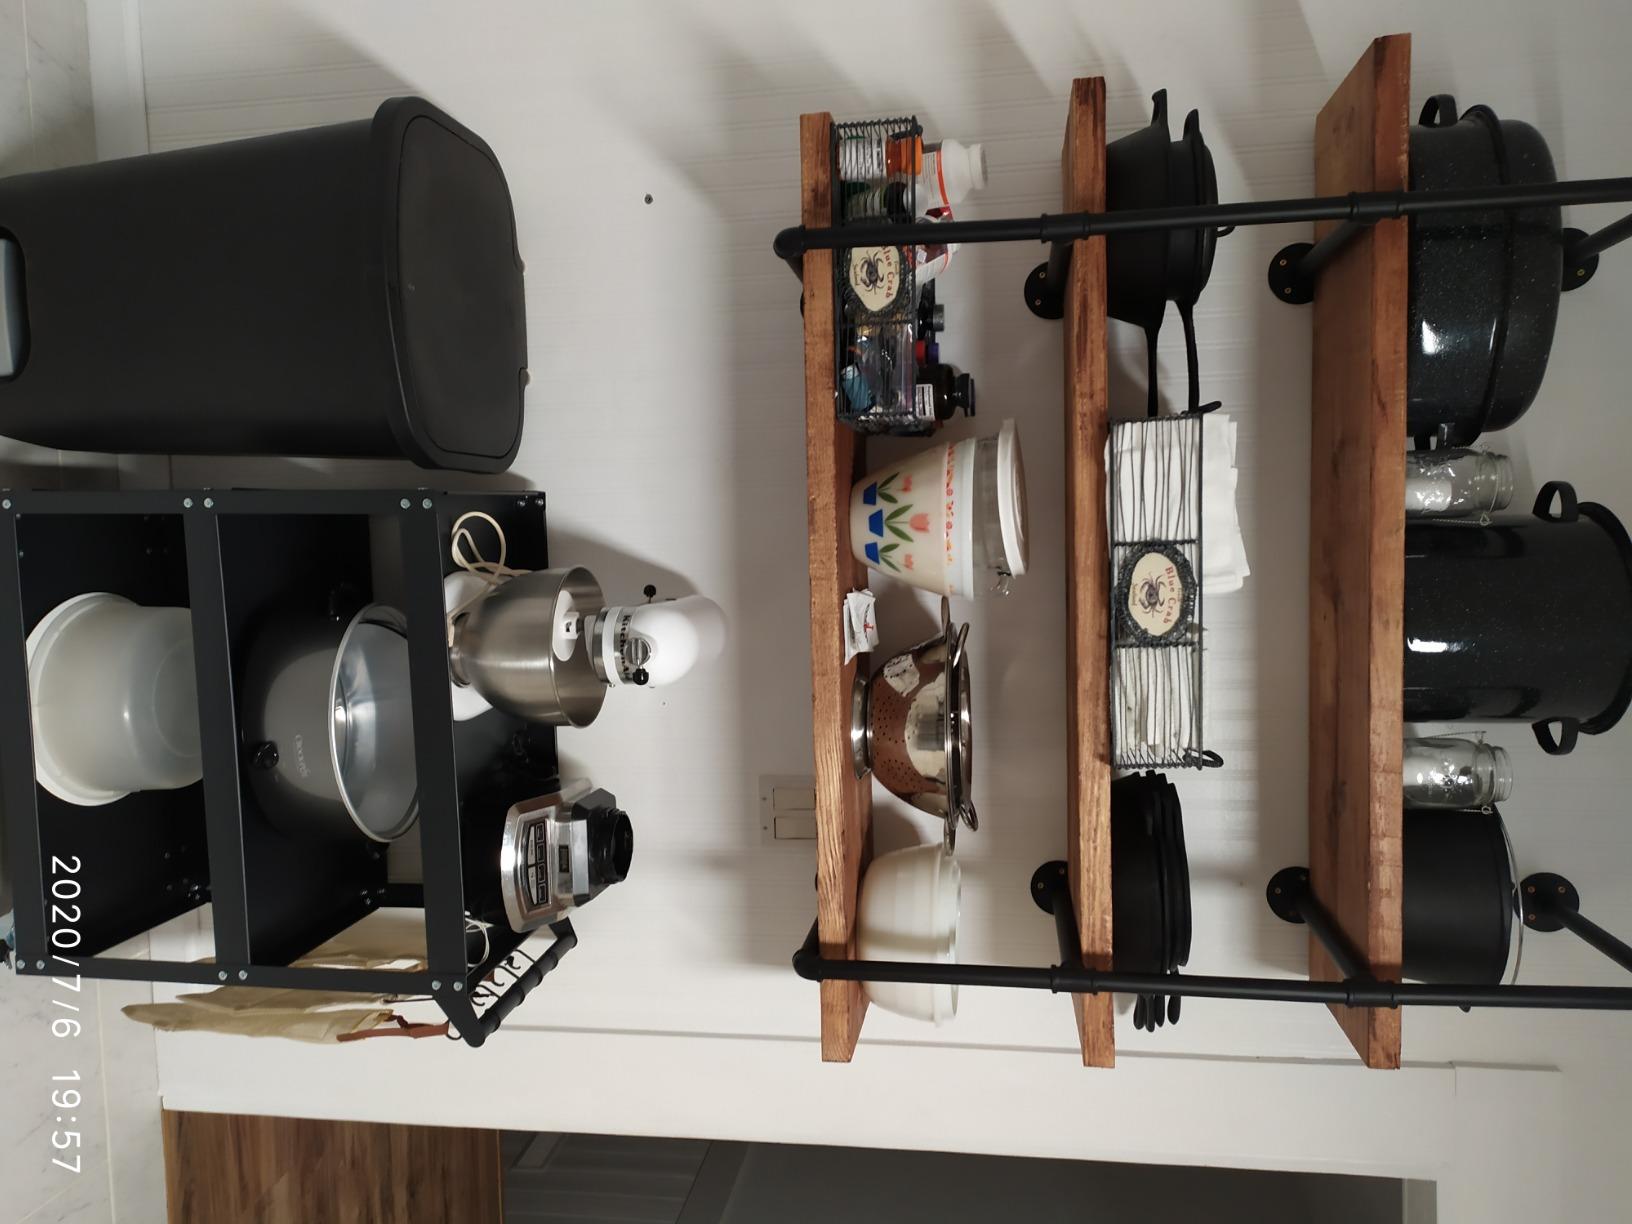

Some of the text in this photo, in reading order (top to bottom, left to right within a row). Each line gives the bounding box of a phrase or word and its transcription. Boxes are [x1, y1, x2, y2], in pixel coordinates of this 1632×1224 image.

[885, 271, 895, 298] Crab
[1163, 565, 1177, 624] Blue Crab
